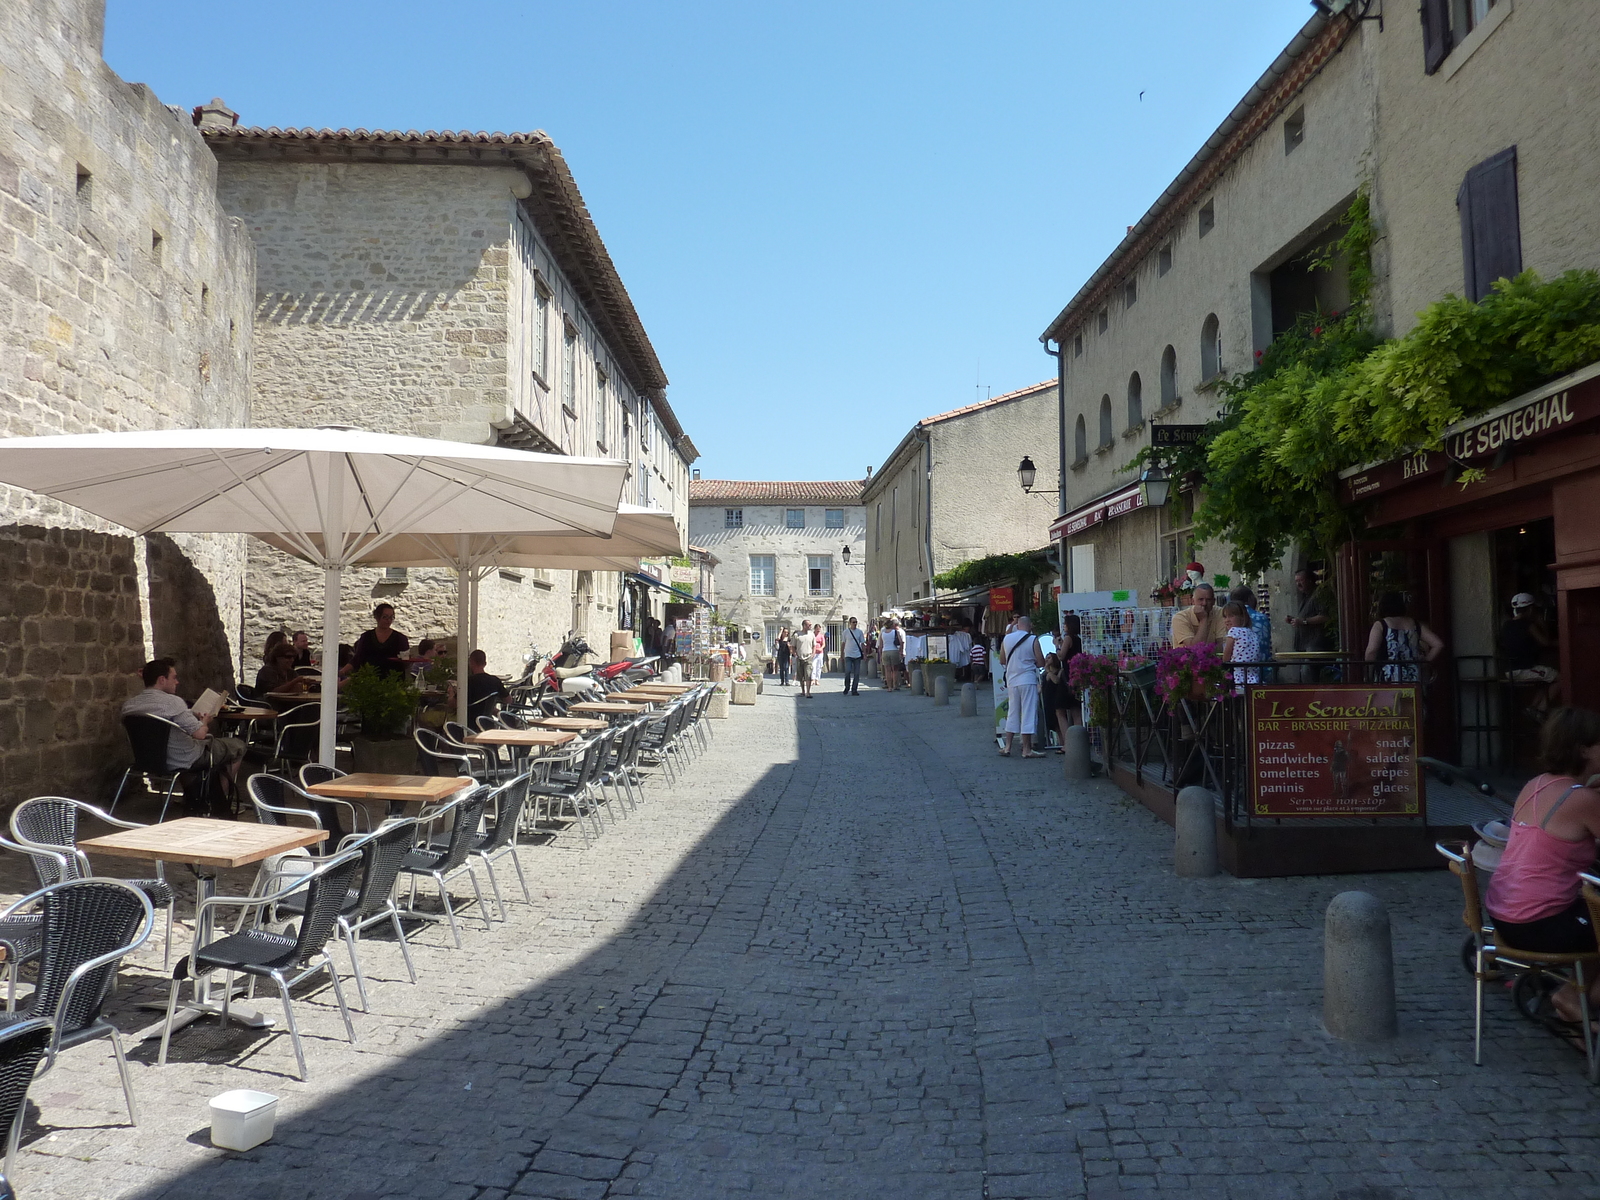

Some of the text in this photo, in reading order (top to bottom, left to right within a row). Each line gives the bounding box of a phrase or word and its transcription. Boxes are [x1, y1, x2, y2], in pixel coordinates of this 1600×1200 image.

[1454, 391, 1575, 460] LE SENECHAL
[1157, 429, 1170, 442] Le
[1403, 453, 1429, 480] BAR
[1270, 692, 1399, 718] Le Senechal
[1257, 721, 1280, 731] BAR
[1291, 720, 1350, 731] BRASSERIE
[1359, 720, 1410, 730] PIZZERIA
[1258, 739, 1296, 753] pizzas
[1375, 736, 1411, 748] snack
[1259, 752, 1329, 764] sandwiches
[1365, 751, 1410, 763] salades
[1259, 766, 1320, 778] omelettes
[1260, 782, 1305, 797] paninis
[1372, 781, 1410, 797] glaces
[1288, 796, 1386, 808] Service non-stop
